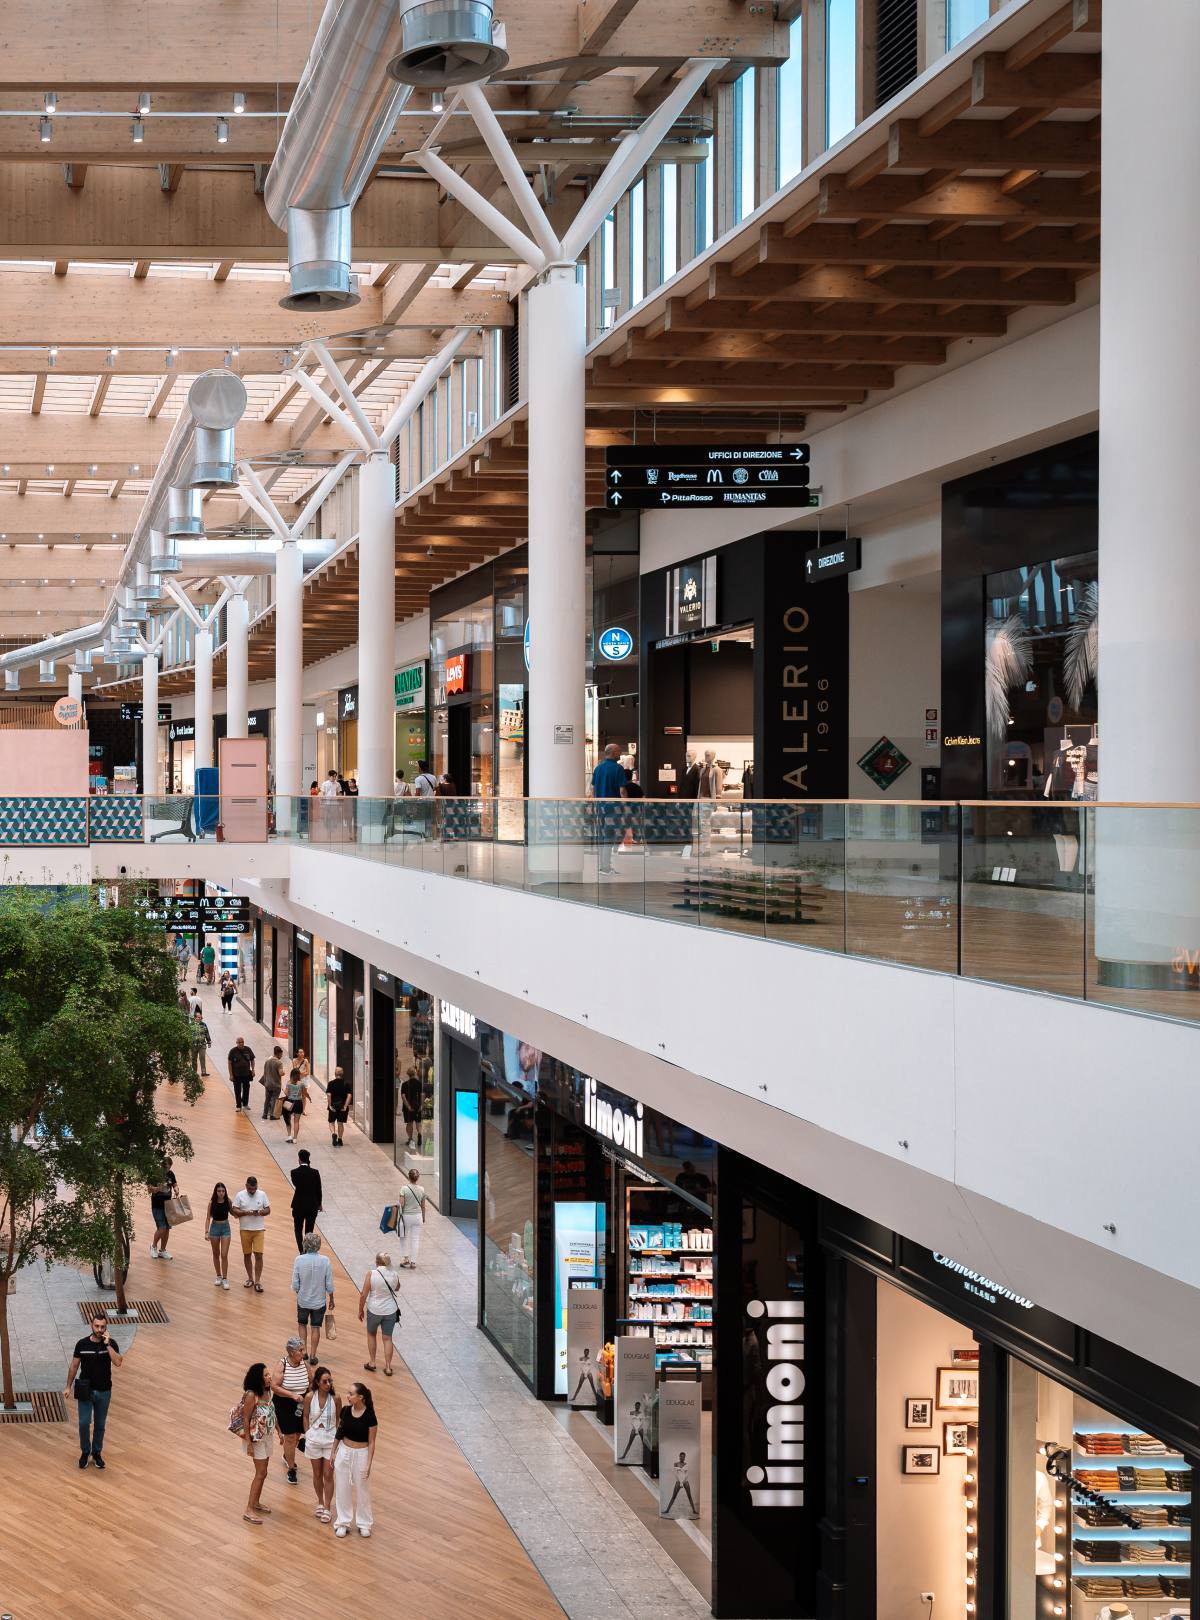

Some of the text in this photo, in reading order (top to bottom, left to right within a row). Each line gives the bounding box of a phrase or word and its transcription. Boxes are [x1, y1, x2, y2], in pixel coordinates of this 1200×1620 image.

[708, 451, 783, 459] UFFICI DI DIREZIONE
[671, 493, 767, 502] PittaRosso HUMANITAS
[818, 551, 845, 569] DIREZIONE
[679, 601, 702, 614] VALERIO
[611, 632, 620, 642] N
[612, 646, 620, 655] S
[817, 678, 829, 752] 1966
[584, 1078, 644, 1158] limoni
[623, 1352, 650, 1360] DOUGLAS
[746, 1299, 806, 1507] limoni
